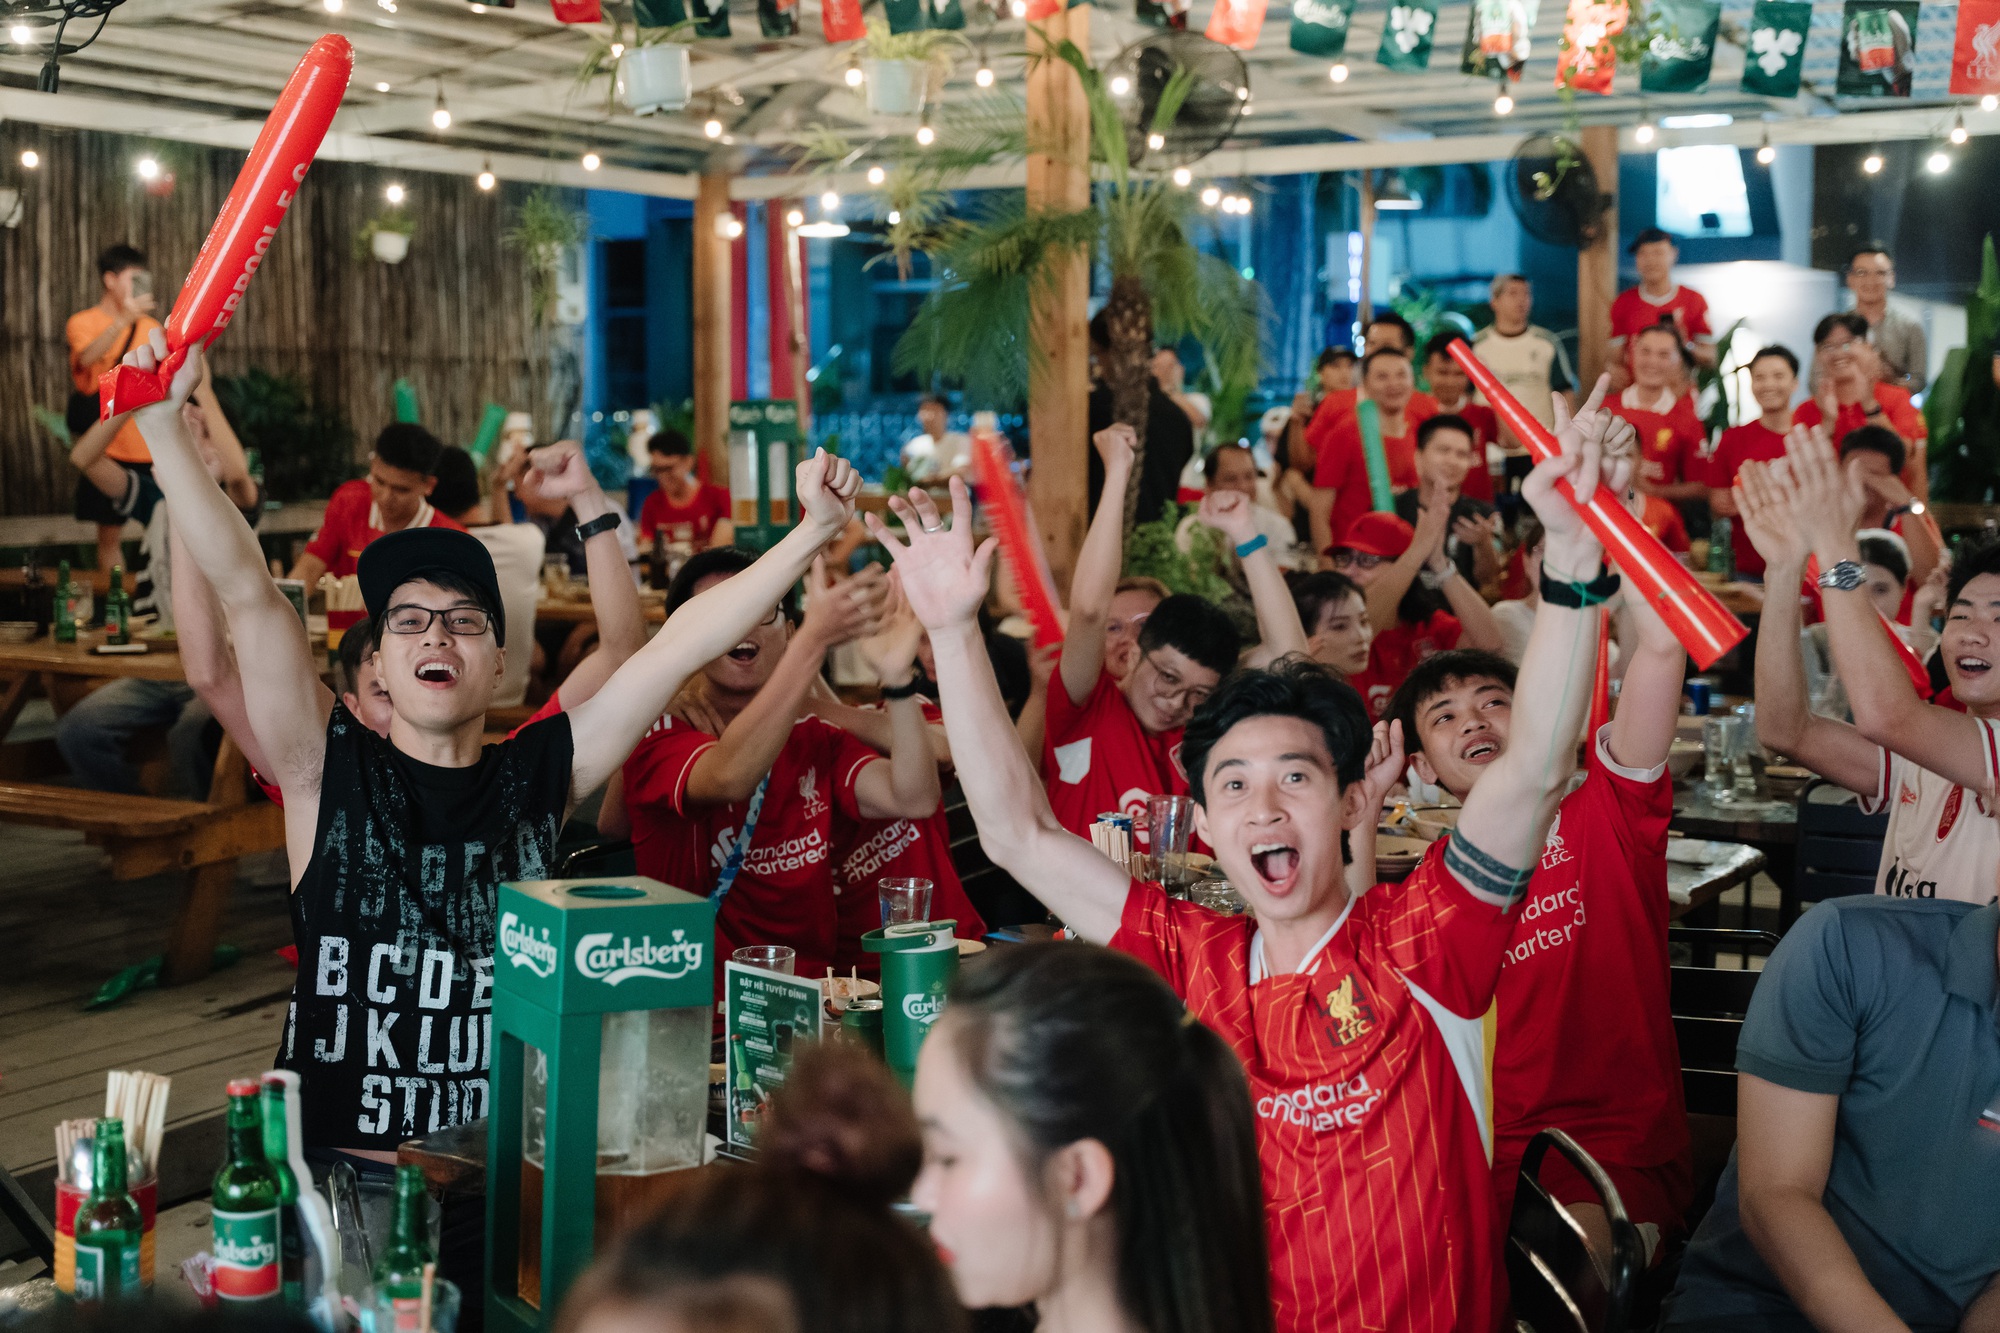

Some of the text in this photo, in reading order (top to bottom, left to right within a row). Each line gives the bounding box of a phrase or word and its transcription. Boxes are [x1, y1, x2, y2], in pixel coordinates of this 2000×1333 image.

[214, 196, 234, 232] PARTNER
[499, 911, 557, 978] Carlsberg
[574, 930, 703, 986] Carlsberg
